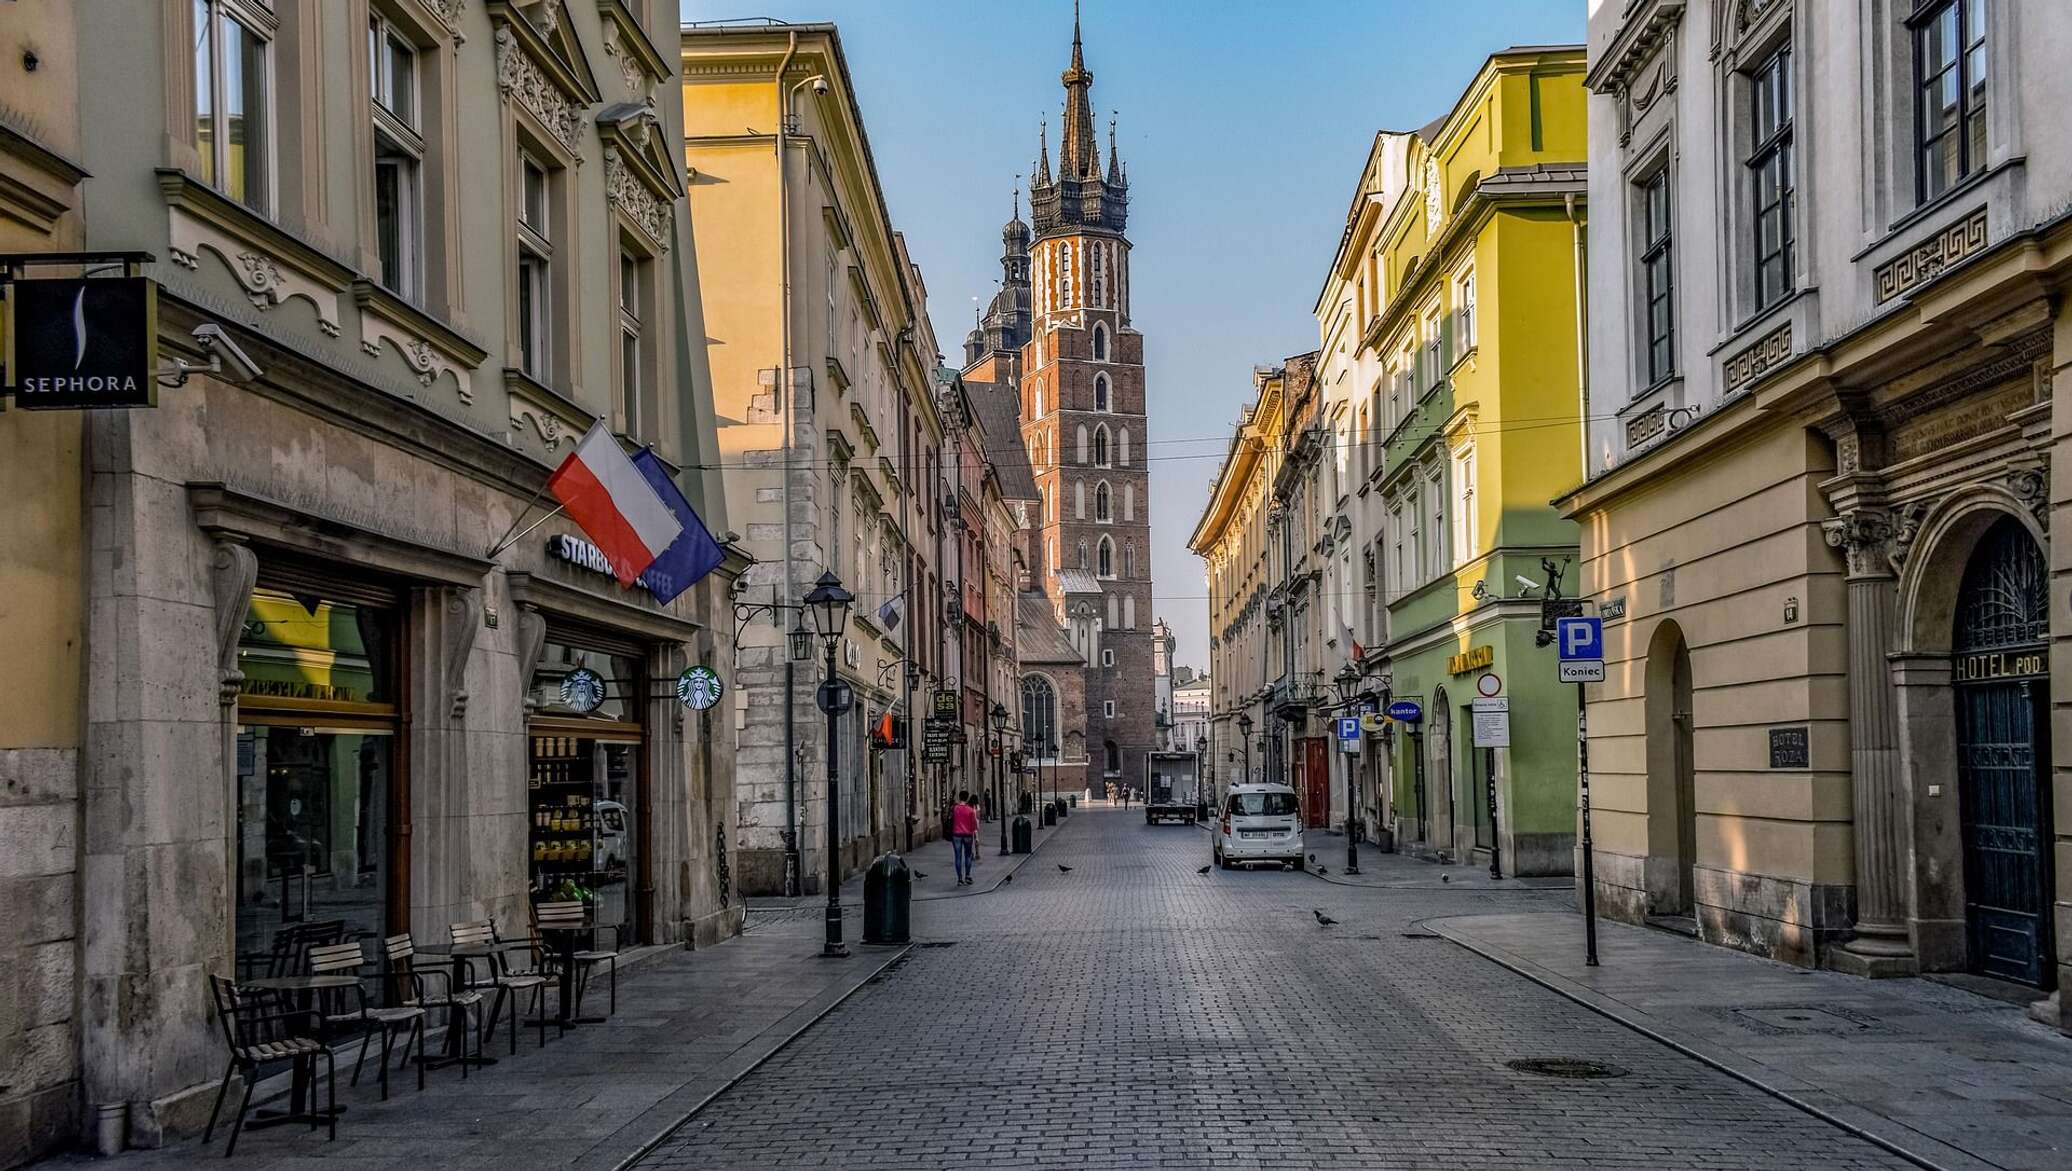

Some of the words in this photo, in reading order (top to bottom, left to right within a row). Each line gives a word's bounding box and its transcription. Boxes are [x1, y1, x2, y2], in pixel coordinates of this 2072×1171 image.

[24, 375, 137, 393] SEPHORA
[1567, 622, 1593, 656] P
[1563, 666, 1600, 676] Koniec
[1957, 653, 2010, 680] HOTEL
[2015, 656, 2040, 676] POD
[1390, 708, 1417, 716] kantor
[1342, 719, 1356, 737] P
[1772, 732, 1805, 748] HOTEL
